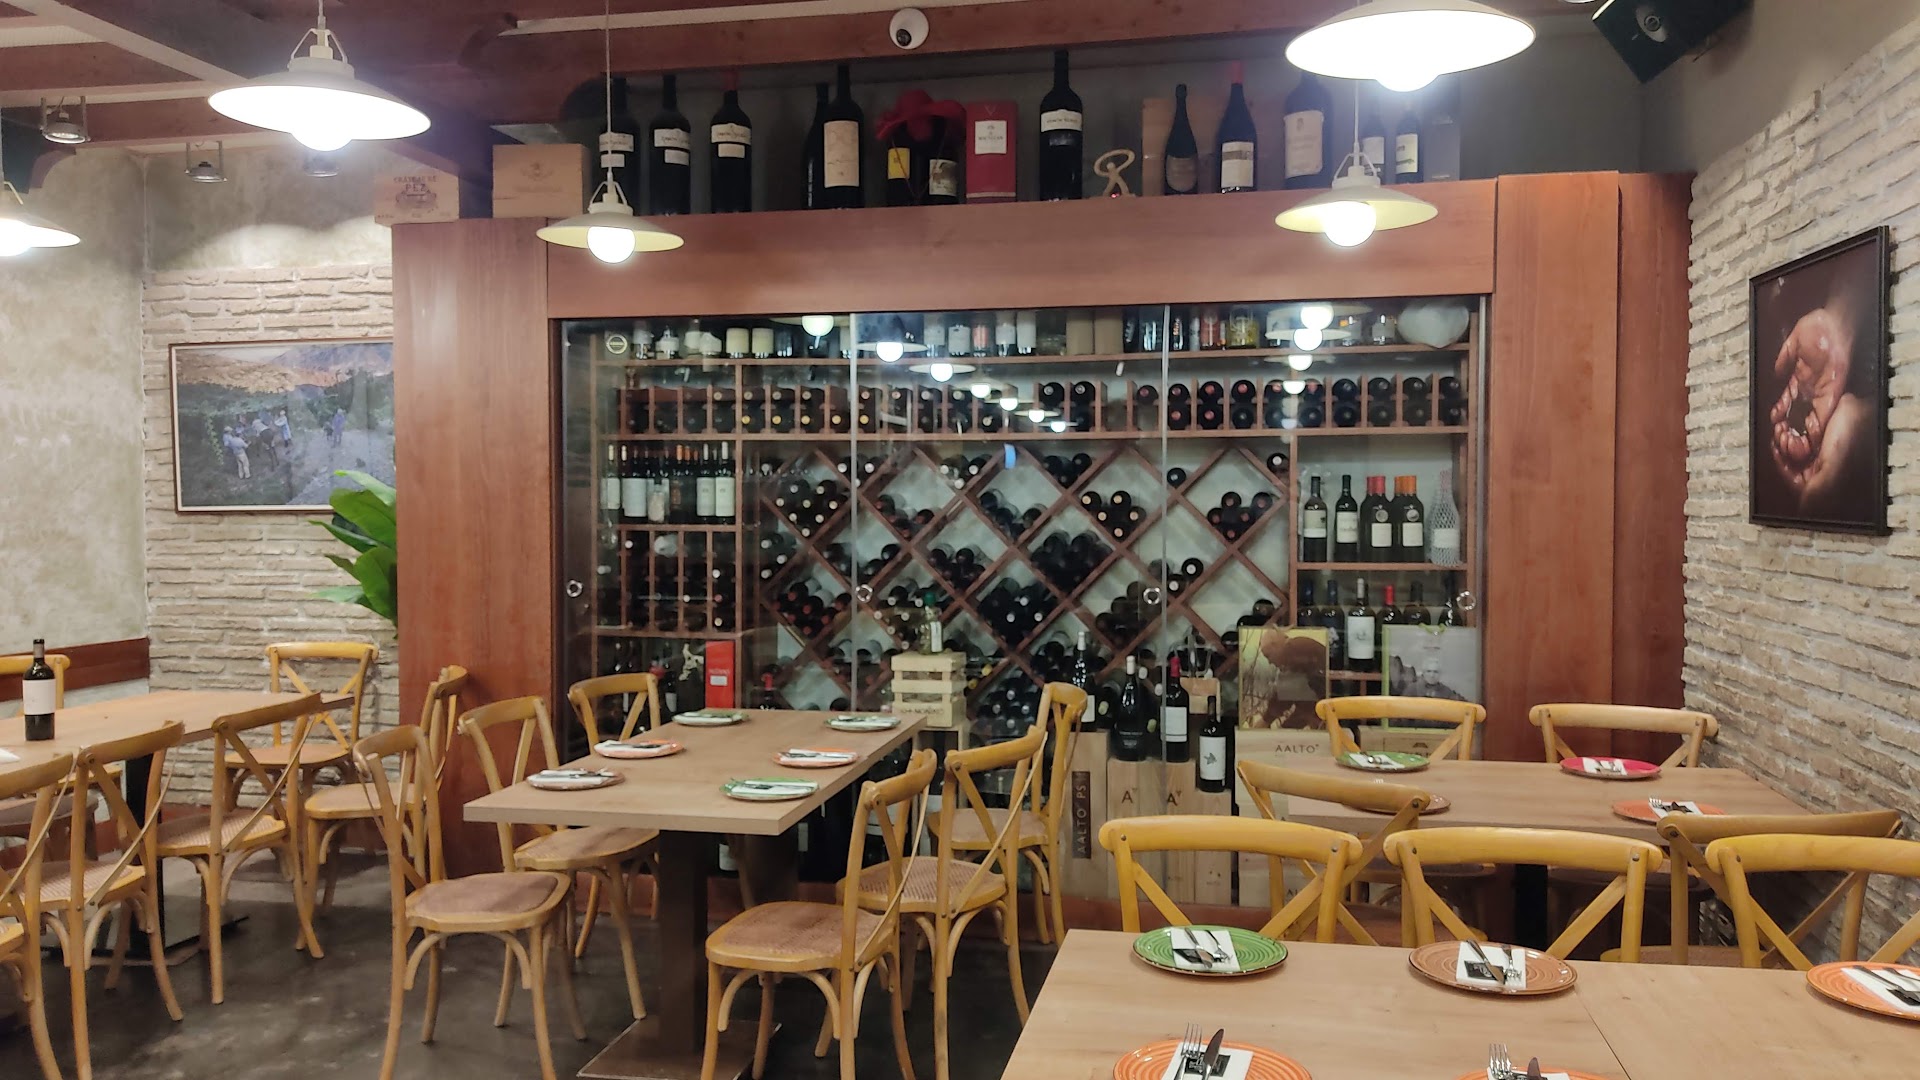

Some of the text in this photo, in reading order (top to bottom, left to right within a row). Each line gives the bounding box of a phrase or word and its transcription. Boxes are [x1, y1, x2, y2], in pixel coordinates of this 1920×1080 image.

[405, 183, 426, 192] PEZ
[1075, 784, 1087, 854] AALTO PS
